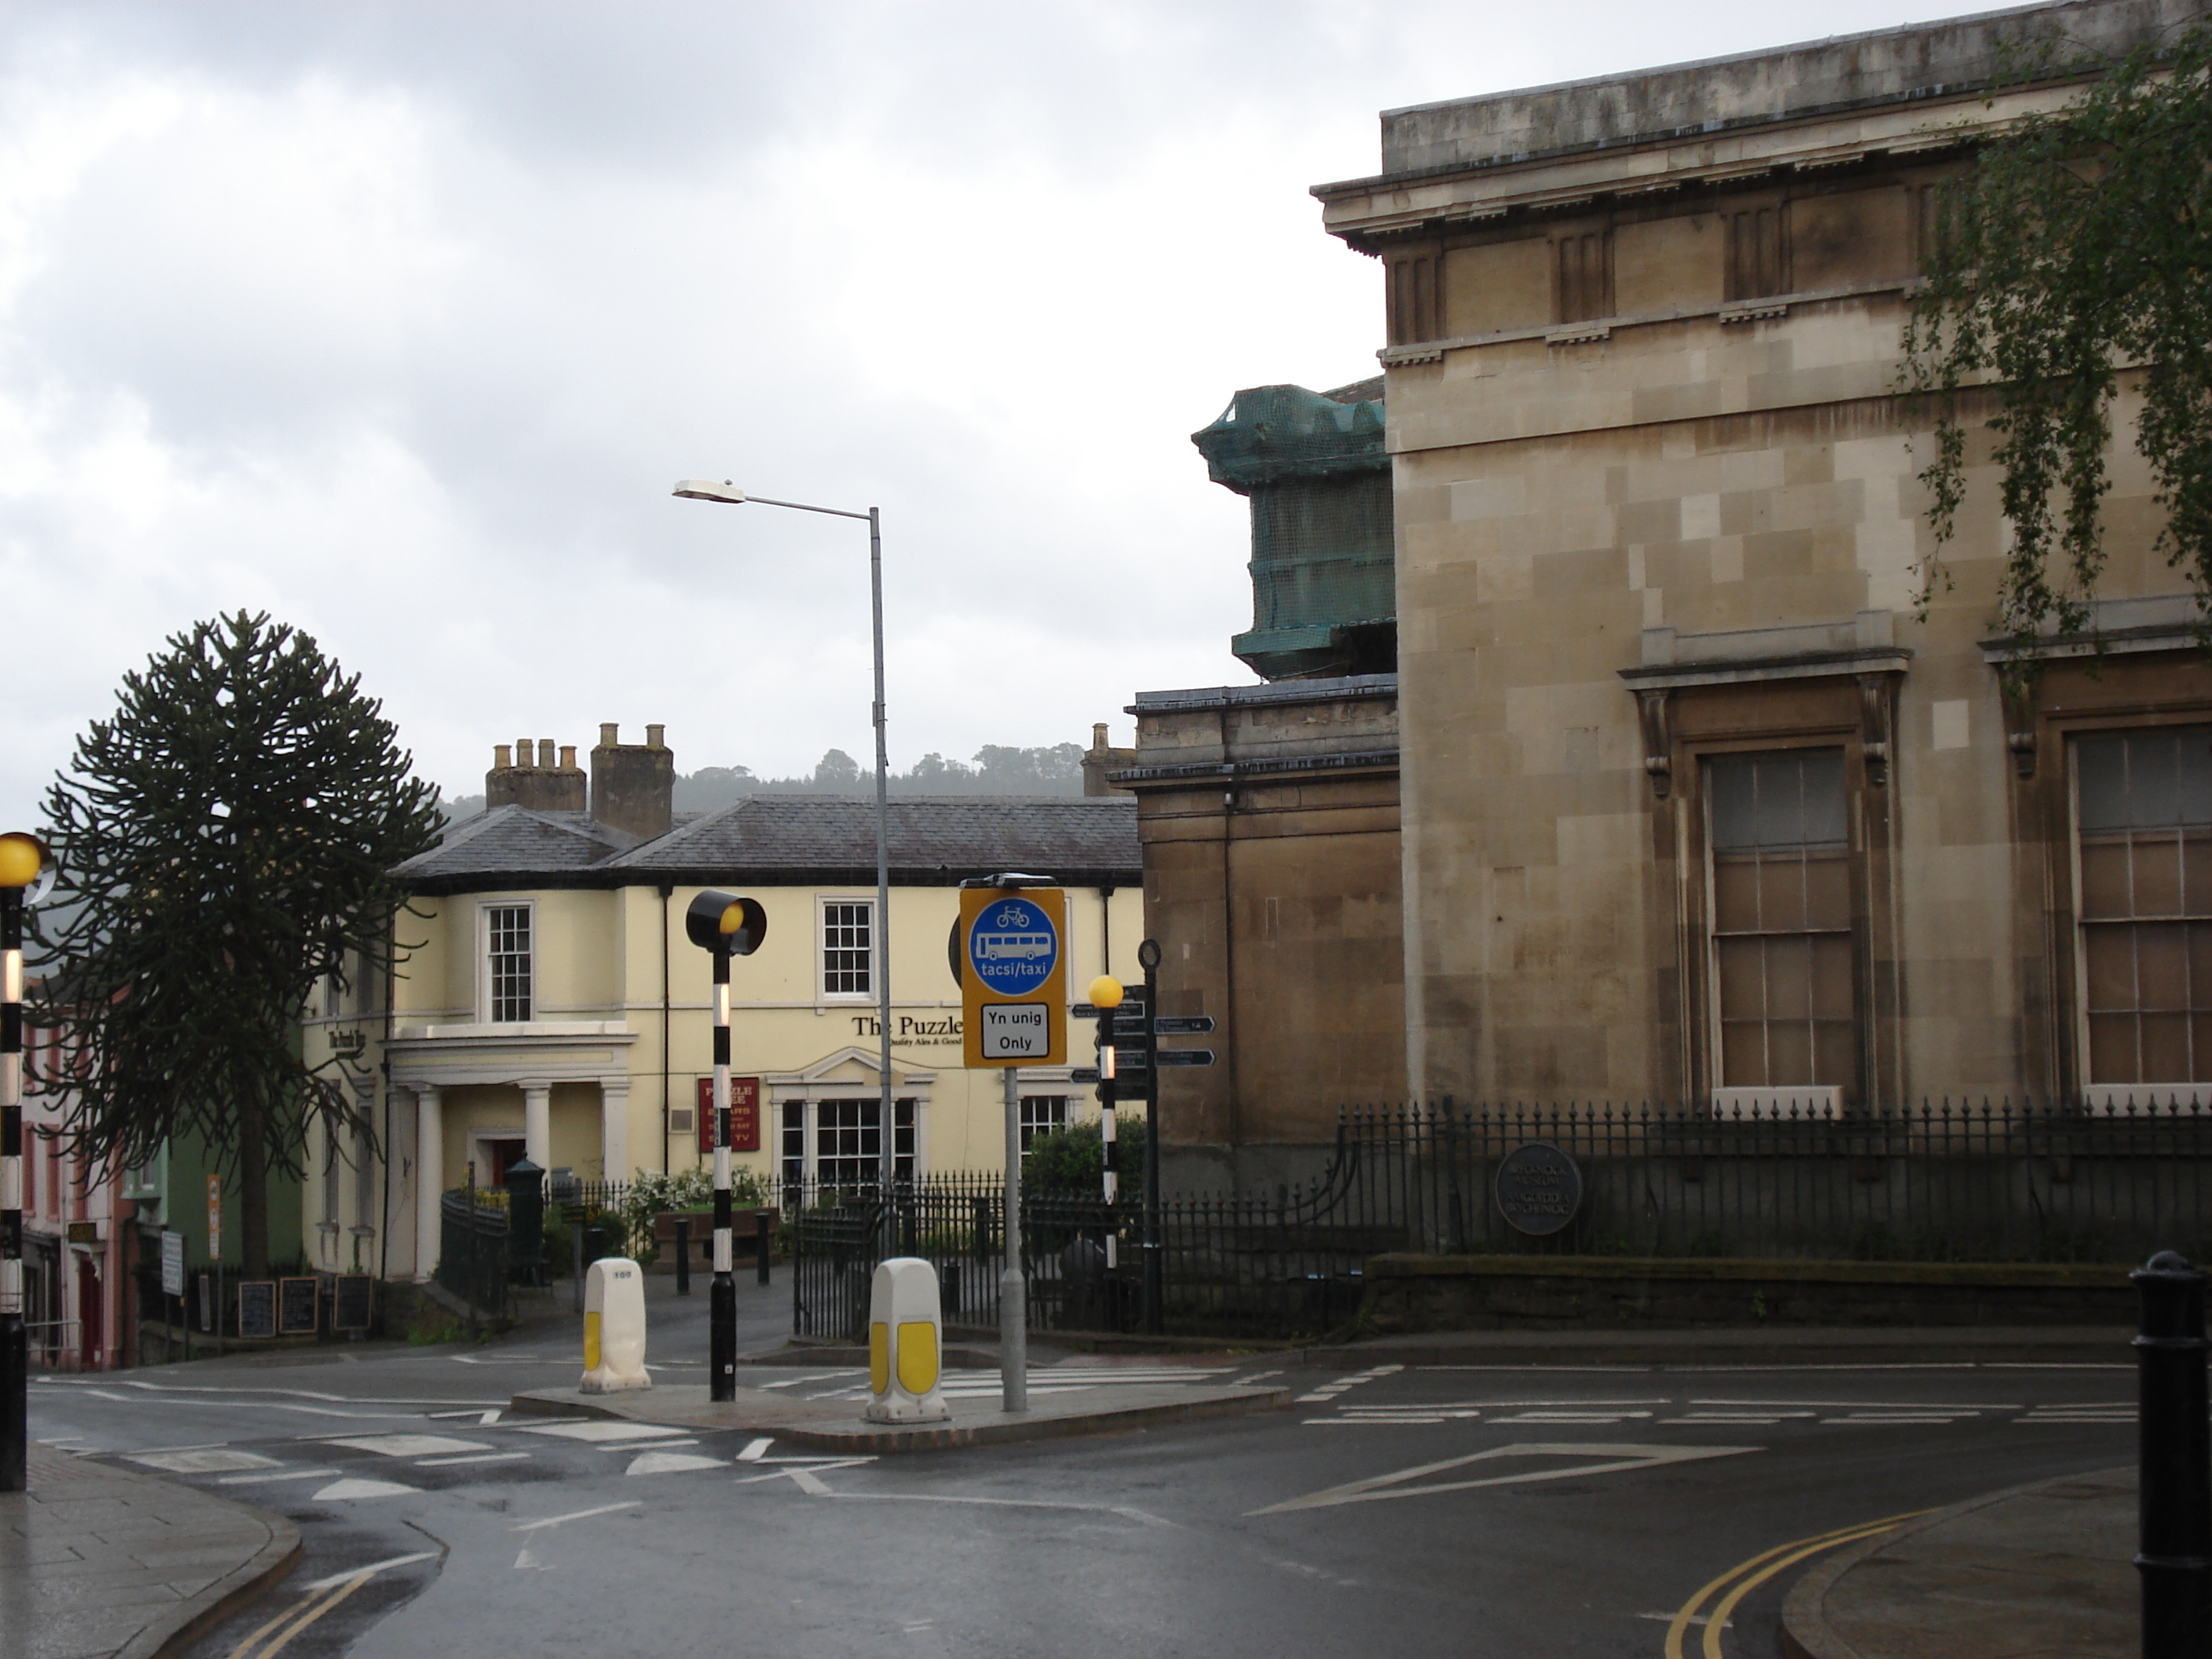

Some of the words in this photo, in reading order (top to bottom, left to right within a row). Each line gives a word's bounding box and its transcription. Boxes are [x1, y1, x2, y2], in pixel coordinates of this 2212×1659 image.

[981, 962, 1046, 978] tacsi/taxi
[899, 1016, 964, 1035] Puzzle
[988, 1011, 1006, 1024] Yn
[1012, 1010, 1042, 1026] unig
[941, 1037, 963, 1046] Good
[999, 1036, 1032, 1051] Only
[705, 1086, 752, 1096] PZLE
